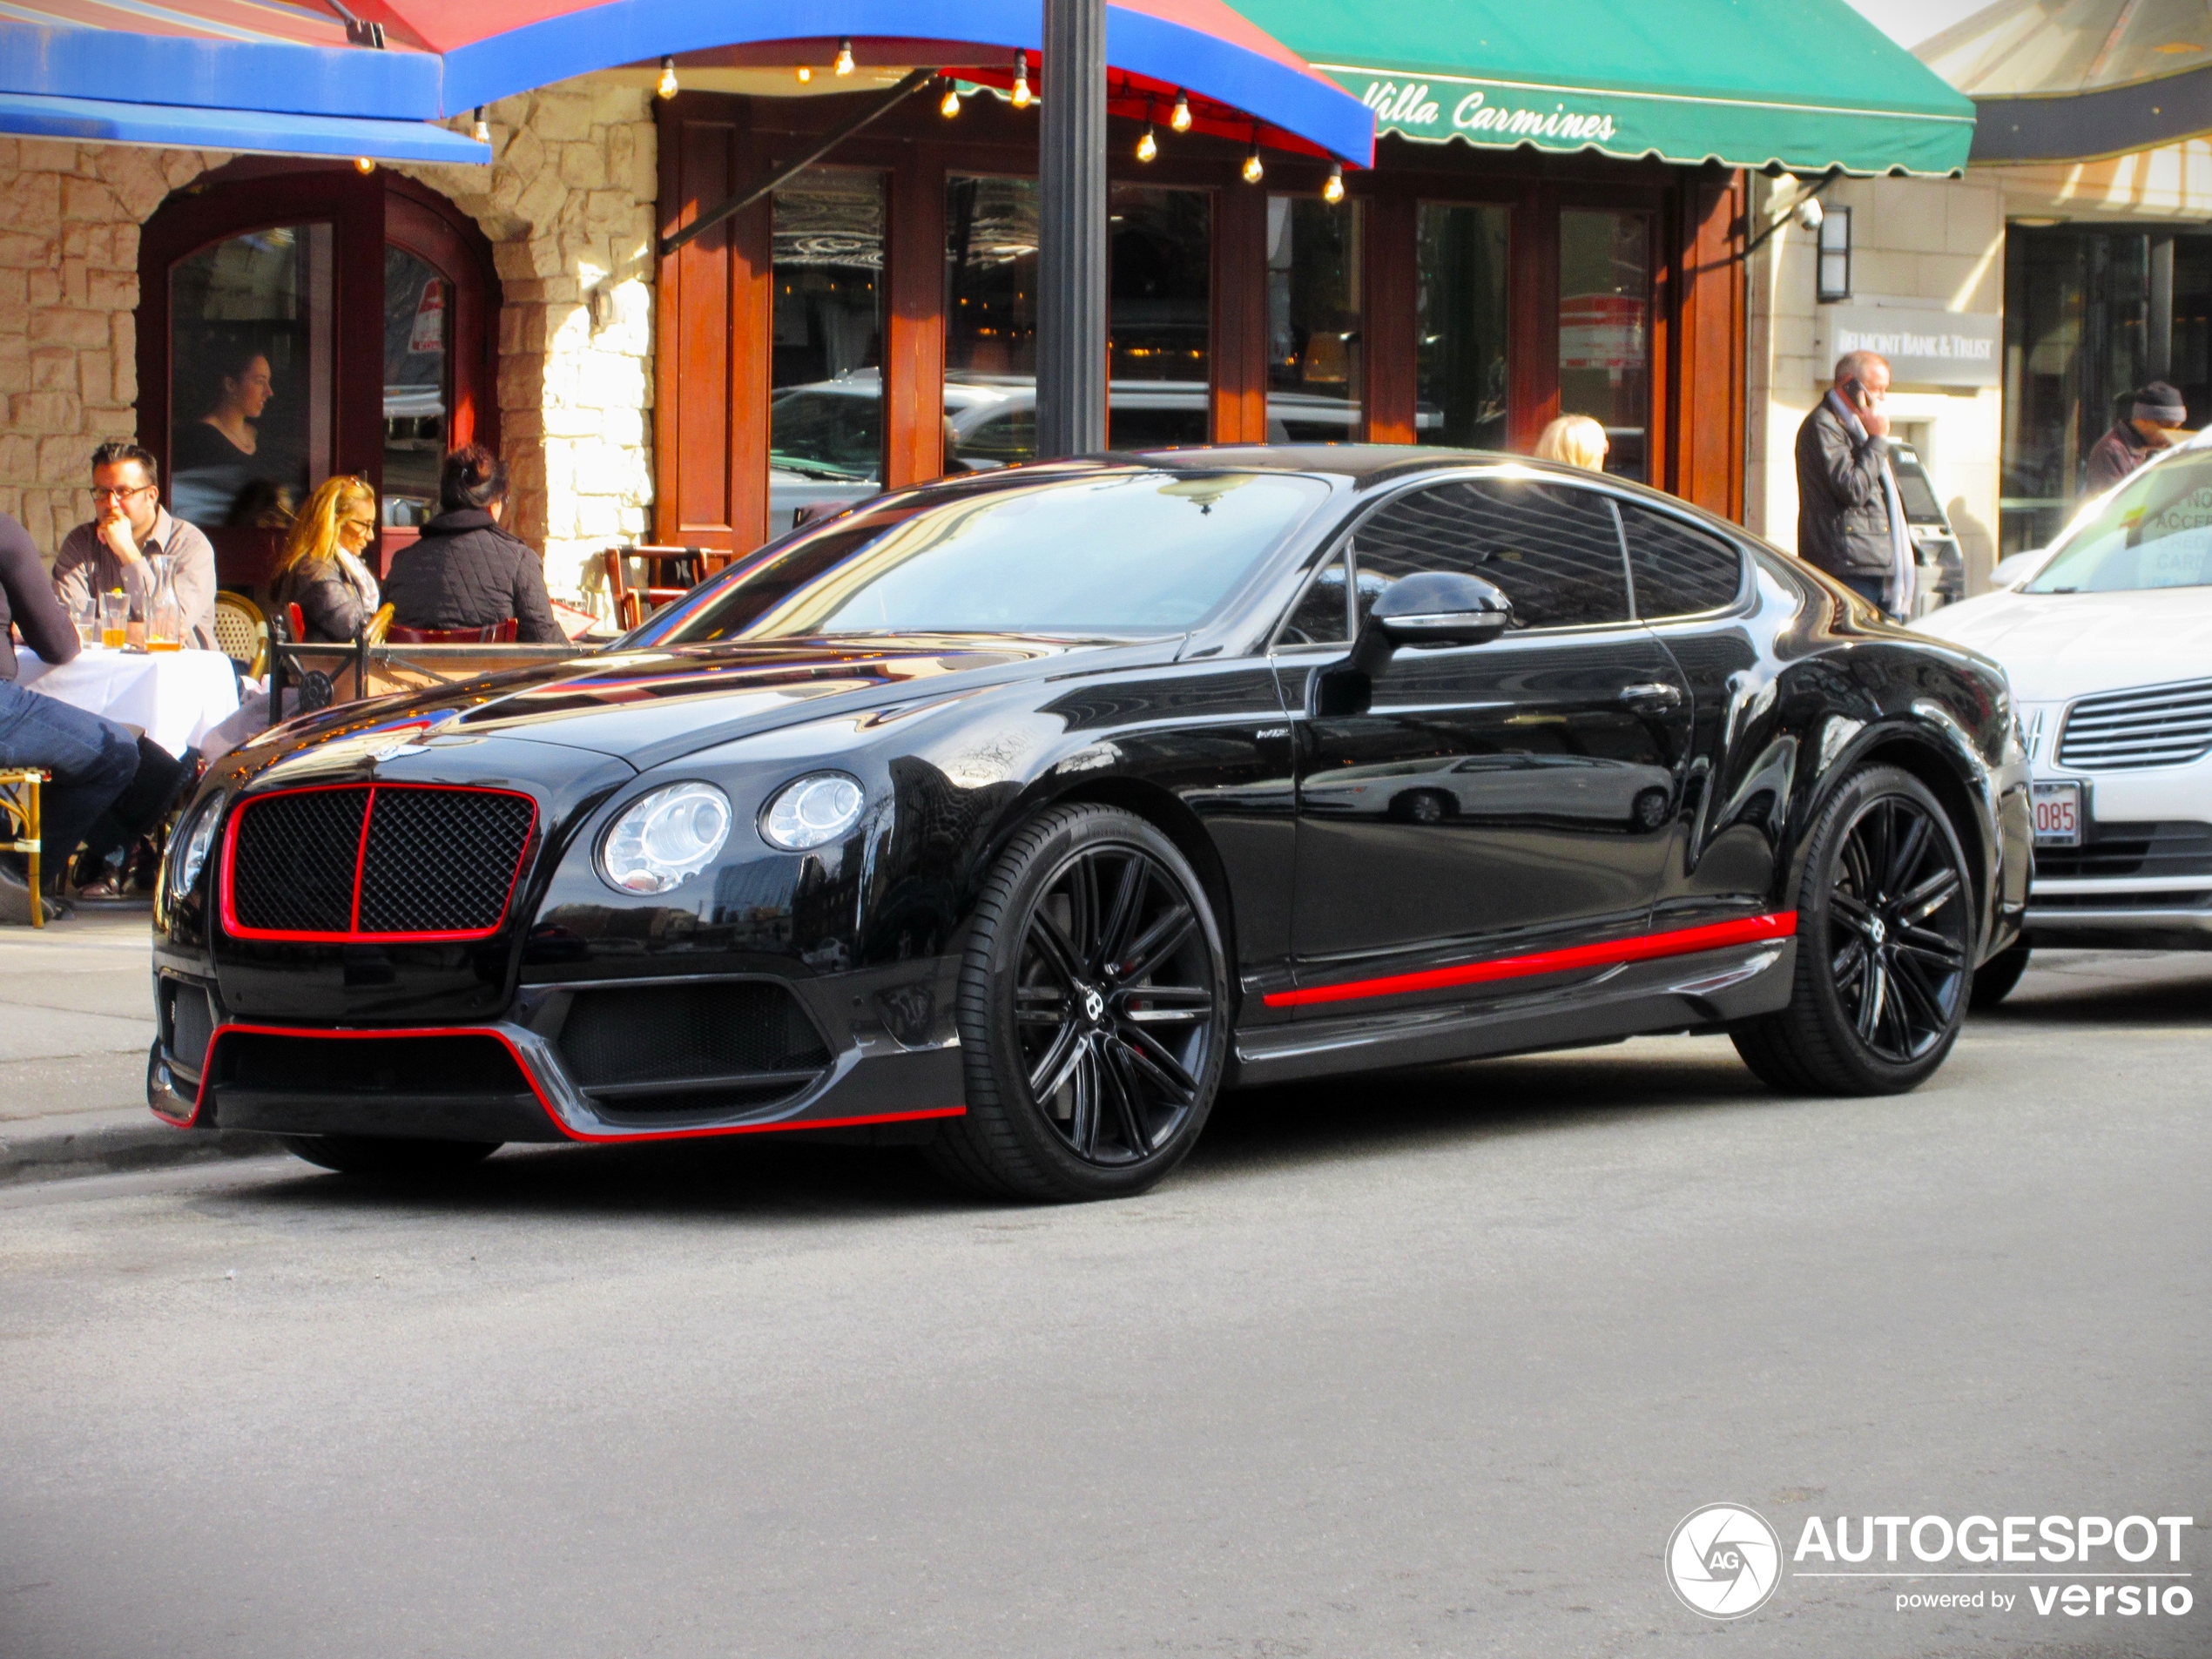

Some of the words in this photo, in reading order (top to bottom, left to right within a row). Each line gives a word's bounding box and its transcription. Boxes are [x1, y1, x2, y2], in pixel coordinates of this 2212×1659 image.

[1363, 81, 1440, 124] Villa
[1452, 91, 1616, 140] Carmines
[1902, 332, 1939, 357] BANK
[1939, 334, 1951, 358] &
[1952, 334, 1993, 359] TRUST
[2036, 802, 2074, 831] 085
